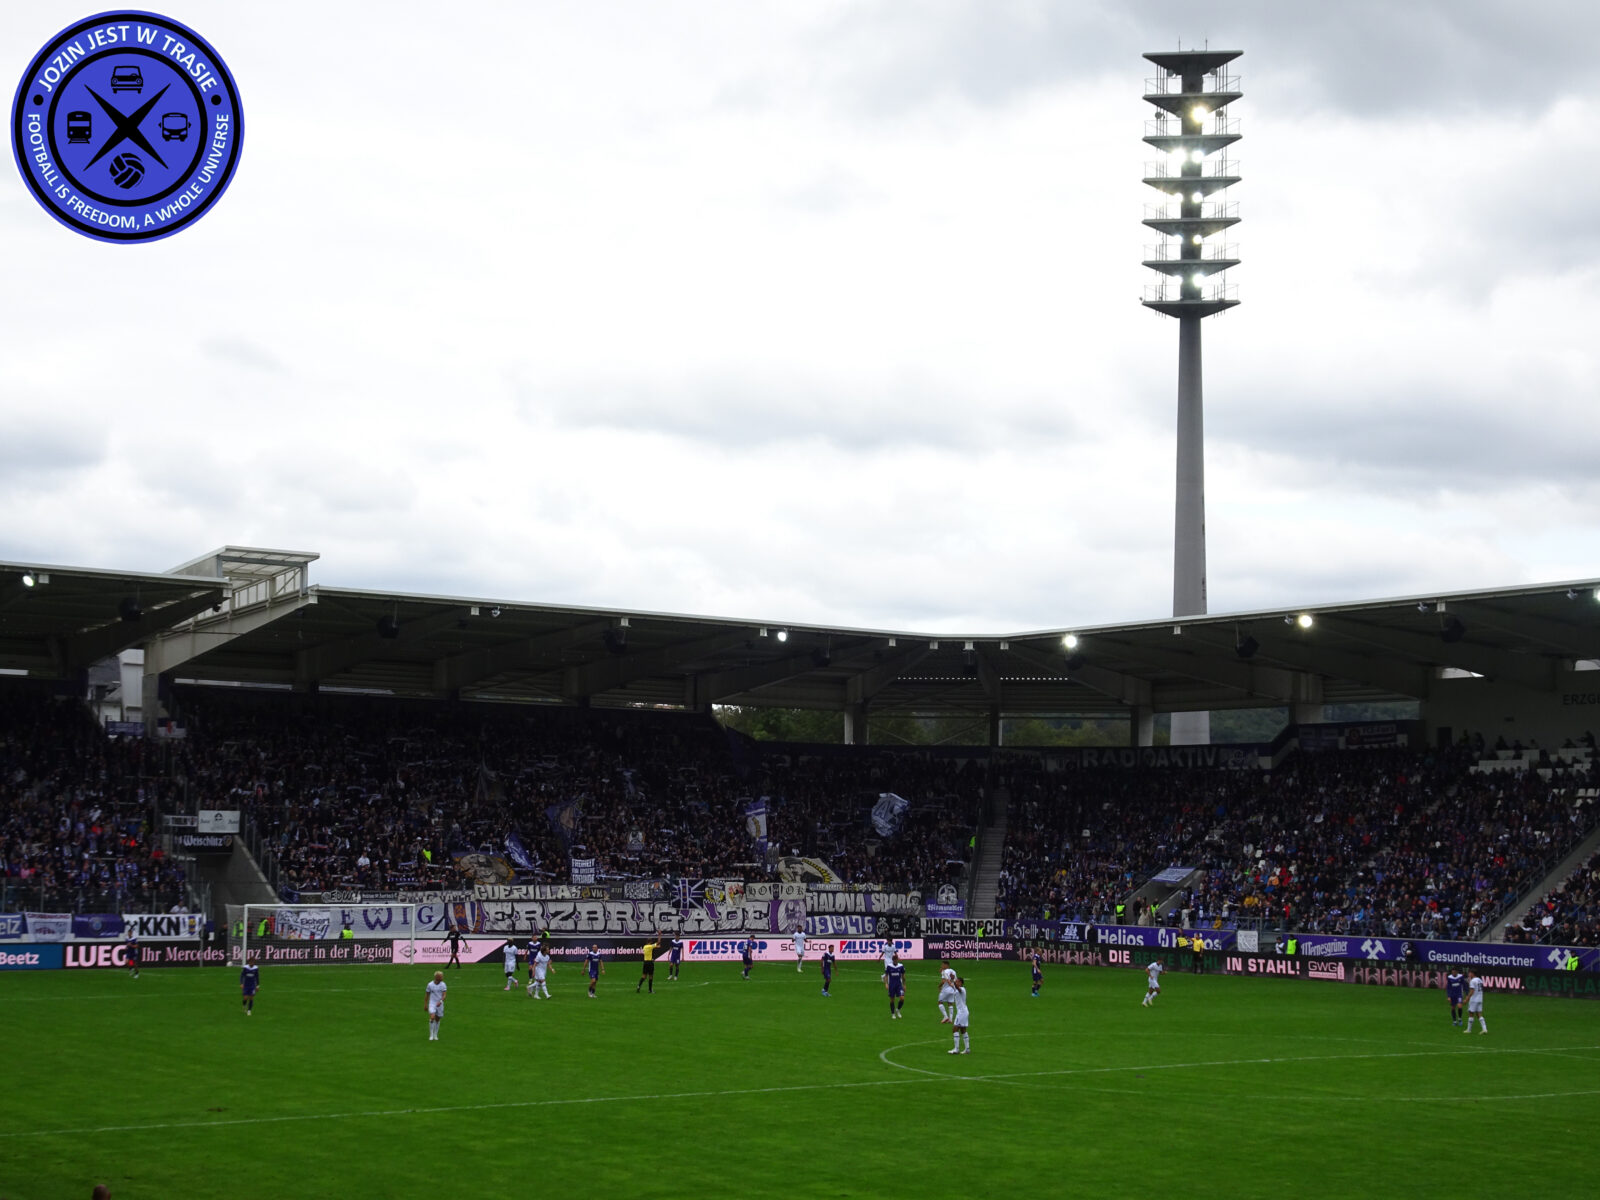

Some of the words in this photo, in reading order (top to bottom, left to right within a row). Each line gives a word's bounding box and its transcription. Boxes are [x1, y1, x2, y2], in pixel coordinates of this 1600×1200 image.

[138, 916, 181, 936] KKN
[1098, 930, 1144, 946] Helios
[65, 945, 127, 967] LUEG
[142, 948, 161, 962] Ihr
[165, 945, 261, 962] Mercedes-Bnz
[265, 944, 310, 960] Partner
[314, 945, 326, 960] in
[330, 944, 350, 959] der
[354, 944, 392, 961] Region
[550, 946, 564, 955] sind
[565, 946, 590, 955] endlich
[840, 941, 912, 954] ALUSTPP
[941, 950, 950, 959] Die
[1109, 949, 1130, 964] DIE
[1181, 953, 1220, 969] WHL
[1226, 956, 1242, 972] IN
[1248, 958, 1301, 975] STAHL!
[1308, 961, 1337, 972] GWG
[1428, 950, 1534, 968] Gesundheitspartner
